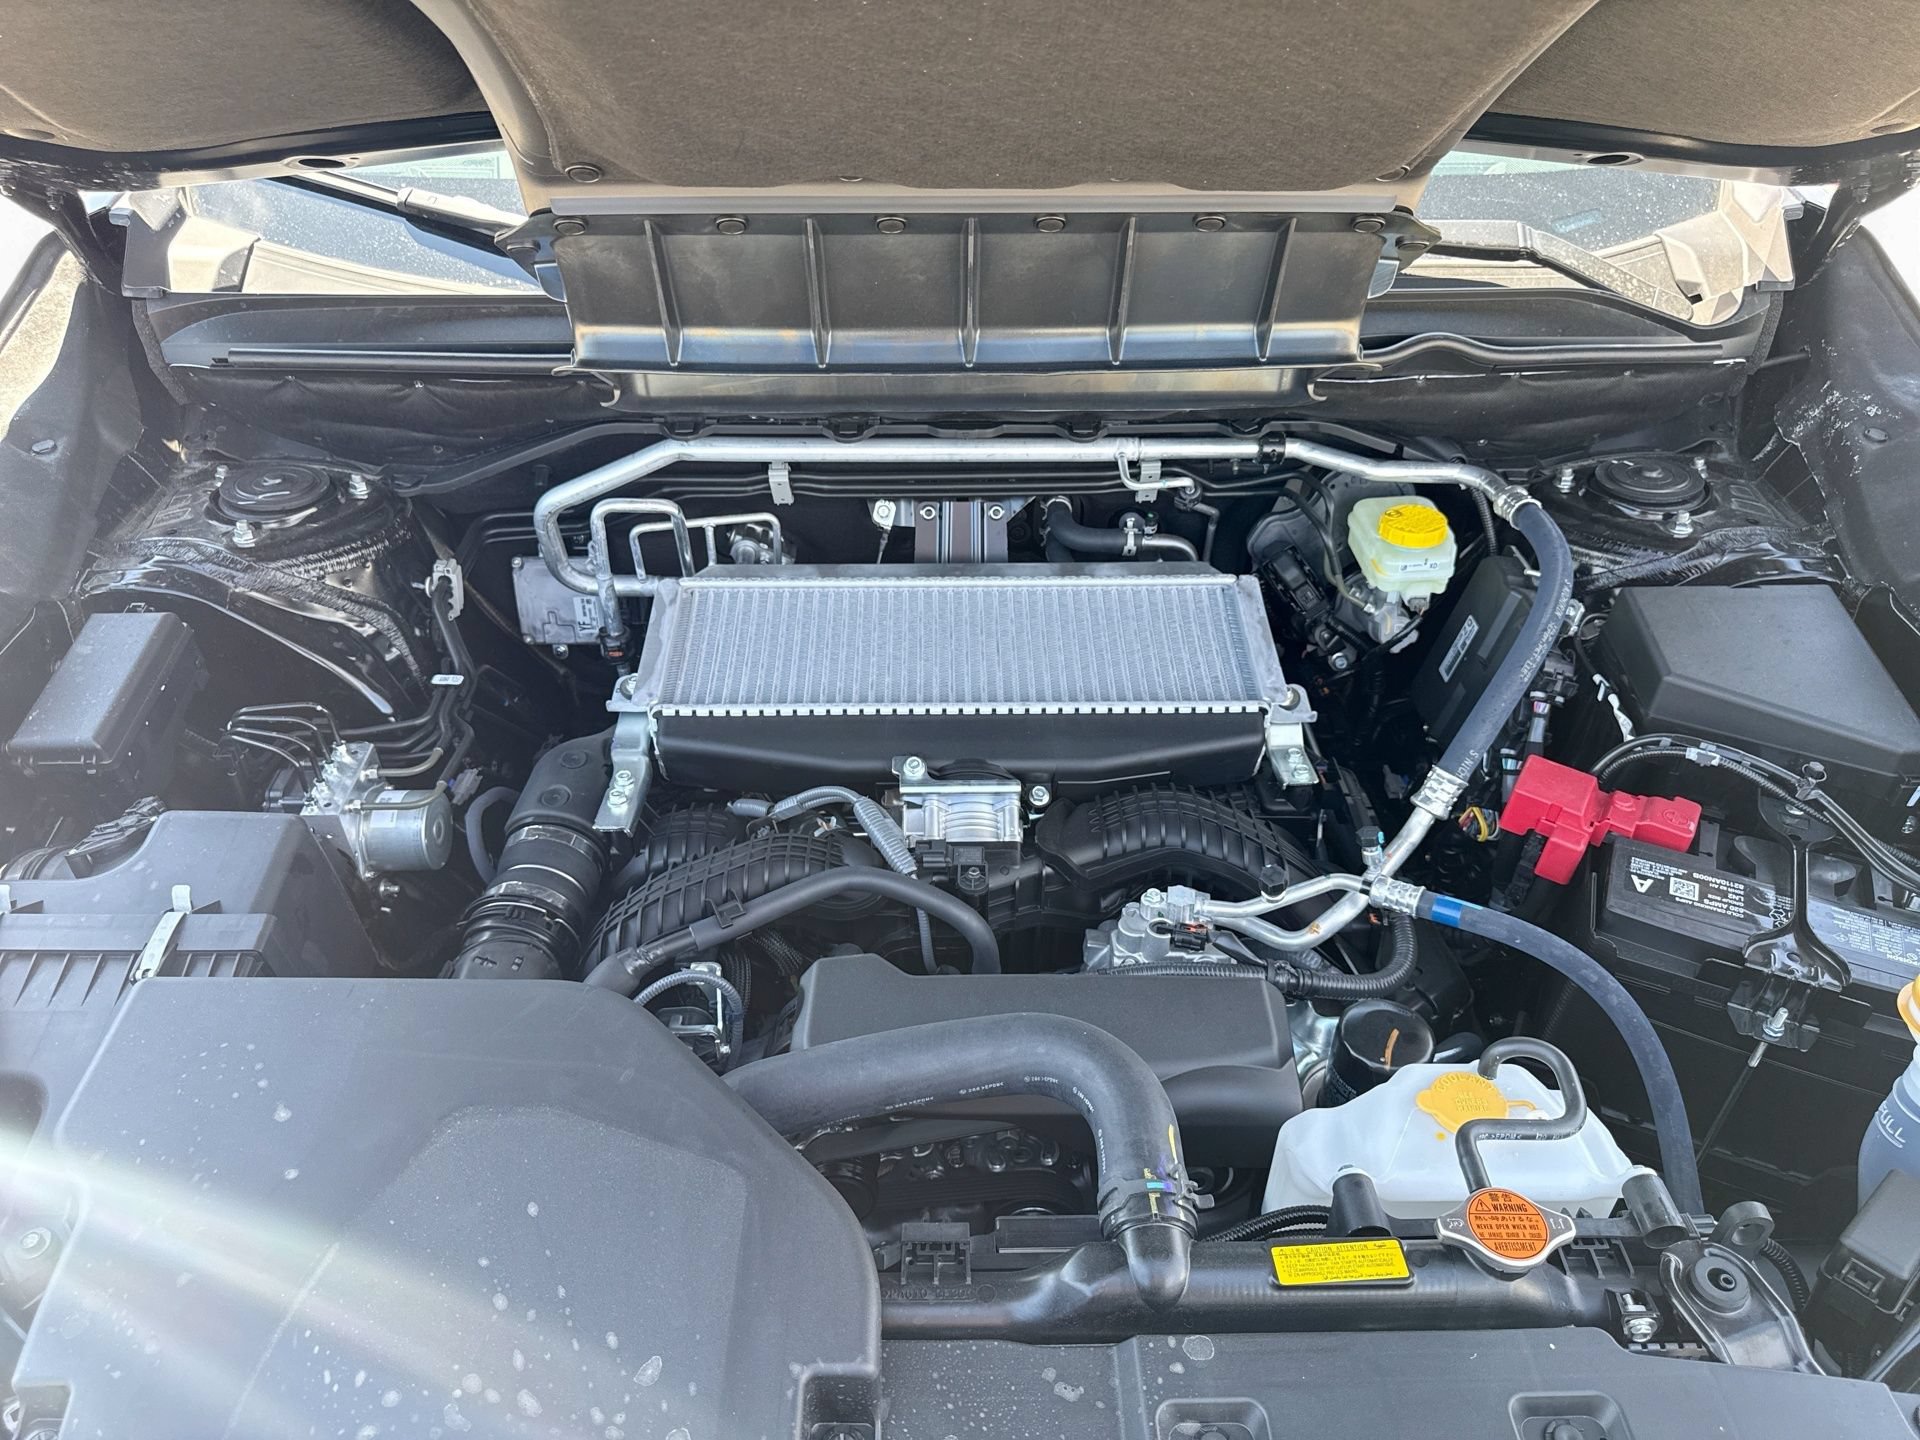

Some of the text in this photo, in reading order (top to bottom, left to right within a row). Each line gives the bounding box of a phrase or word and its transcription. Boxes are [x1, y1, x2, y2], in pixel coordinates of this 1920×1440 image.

[1631, 874, 1655, 893] A
[1703, 898, 1728, 909] AMPS
[1434, 1072, 1495, 1092] COOLANT
[1879, 1100, 1906, 1143] FULL
[1491, 1203, 1528, 1213] WARNING
[1305, 1246, 1333, 1254] CAUTION
[1336, 1243, 1369, 1252] ATTENTION
